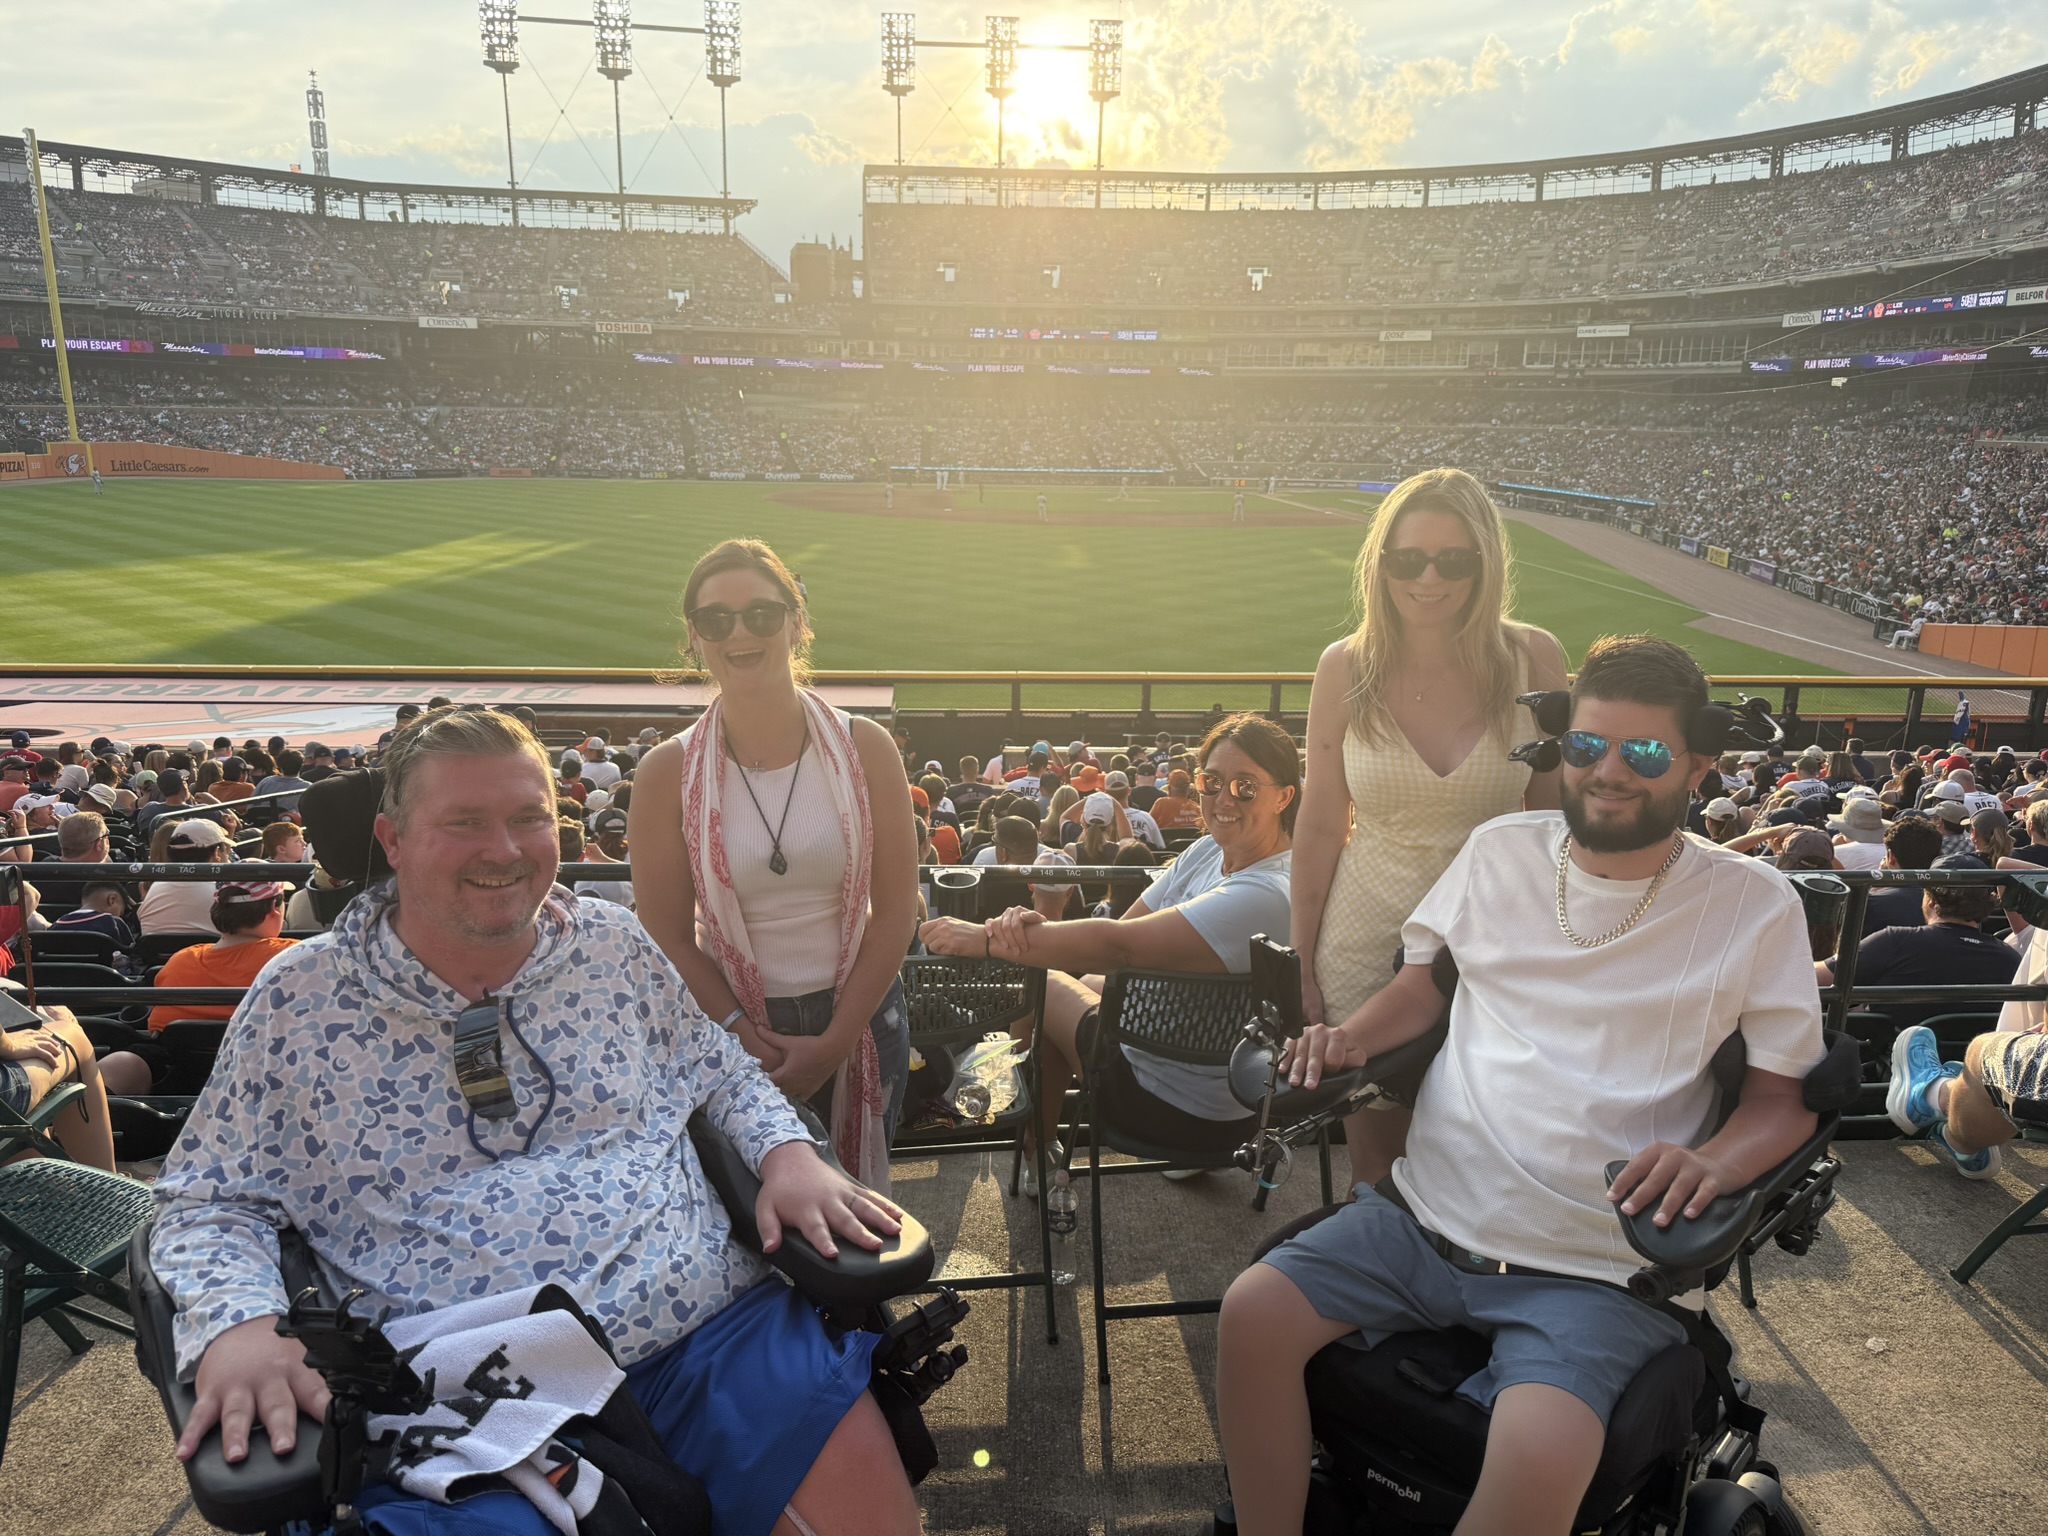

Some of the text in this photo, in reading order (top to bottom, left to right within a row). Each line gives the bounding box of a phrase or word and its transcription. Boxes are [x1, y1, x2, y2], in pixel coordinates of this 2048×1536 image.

[2016, 290, 2044, 301] BELFOR
[213, 308, 277, 320] TIGER CLUB
[597, 322, 650, 333] TOSHIBA
[41, 338, 122, 350] PLA YOUR ESCAPE
[693, 356, 754, 366] PLAN YOUR ESCAPE
[1804, 357, 1850, 369] PLAN YOUR ESCAPE
[968, 364, 983, 372] PLAN
[1002, 365, 1024, 373] ESCAPE
[0, 460, 25, 472] PIZZA!
[151, 866, 220, 874] 148 TAC 13
[1367, 1468, 1421, 1502] permobil
